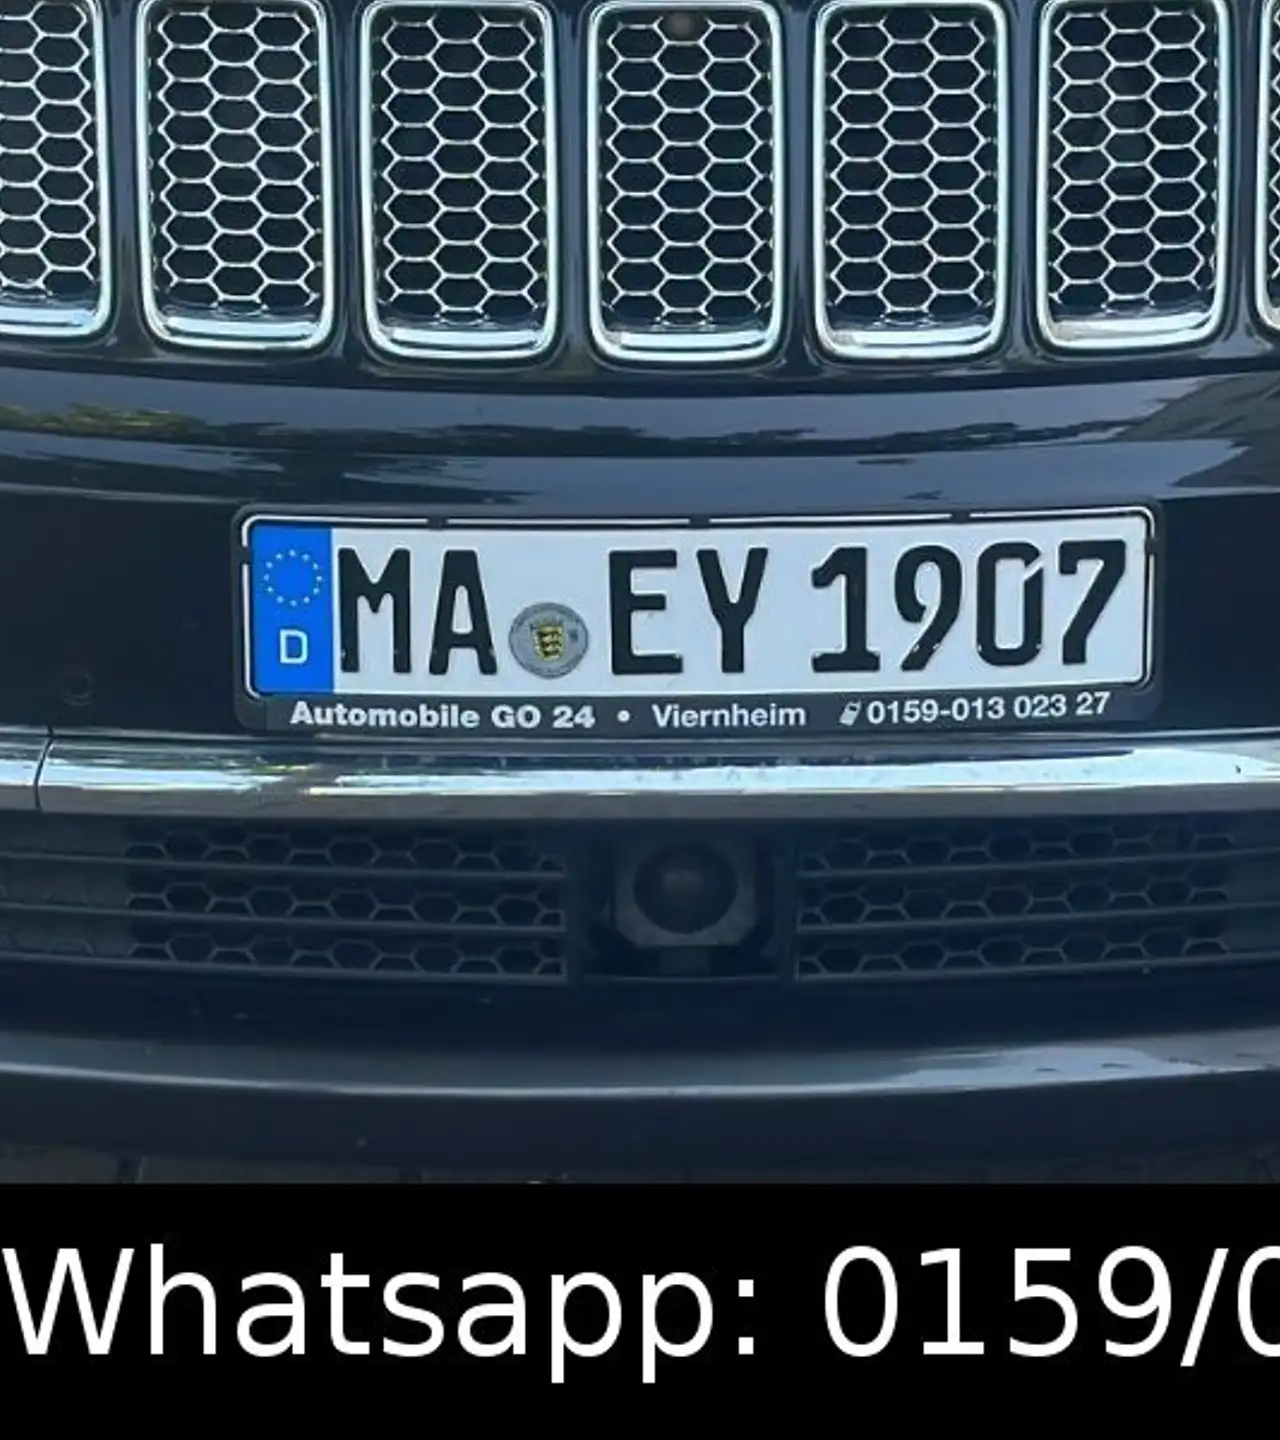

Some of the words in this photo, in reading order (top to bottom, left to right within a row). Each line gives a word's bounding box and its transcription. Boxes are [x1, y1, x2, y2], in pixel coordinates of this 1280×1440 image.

[338, 547, 498, 676] MA
[609, 546, 769, 676] EY
[811, 539, 1127, 673] 1907
[279, 628, 308, 664] D
[290, 700, 480, 729] Automobile
[491, 704, 542, 729] GO
[552, 704, 596, 729] 24
[652, 703, 808, 728] Viernheim
[866, 697, 1006, 725] 0159-013
[1013, 693, 1067, 719] 023
[1075, 690, 1112, 716] 27
